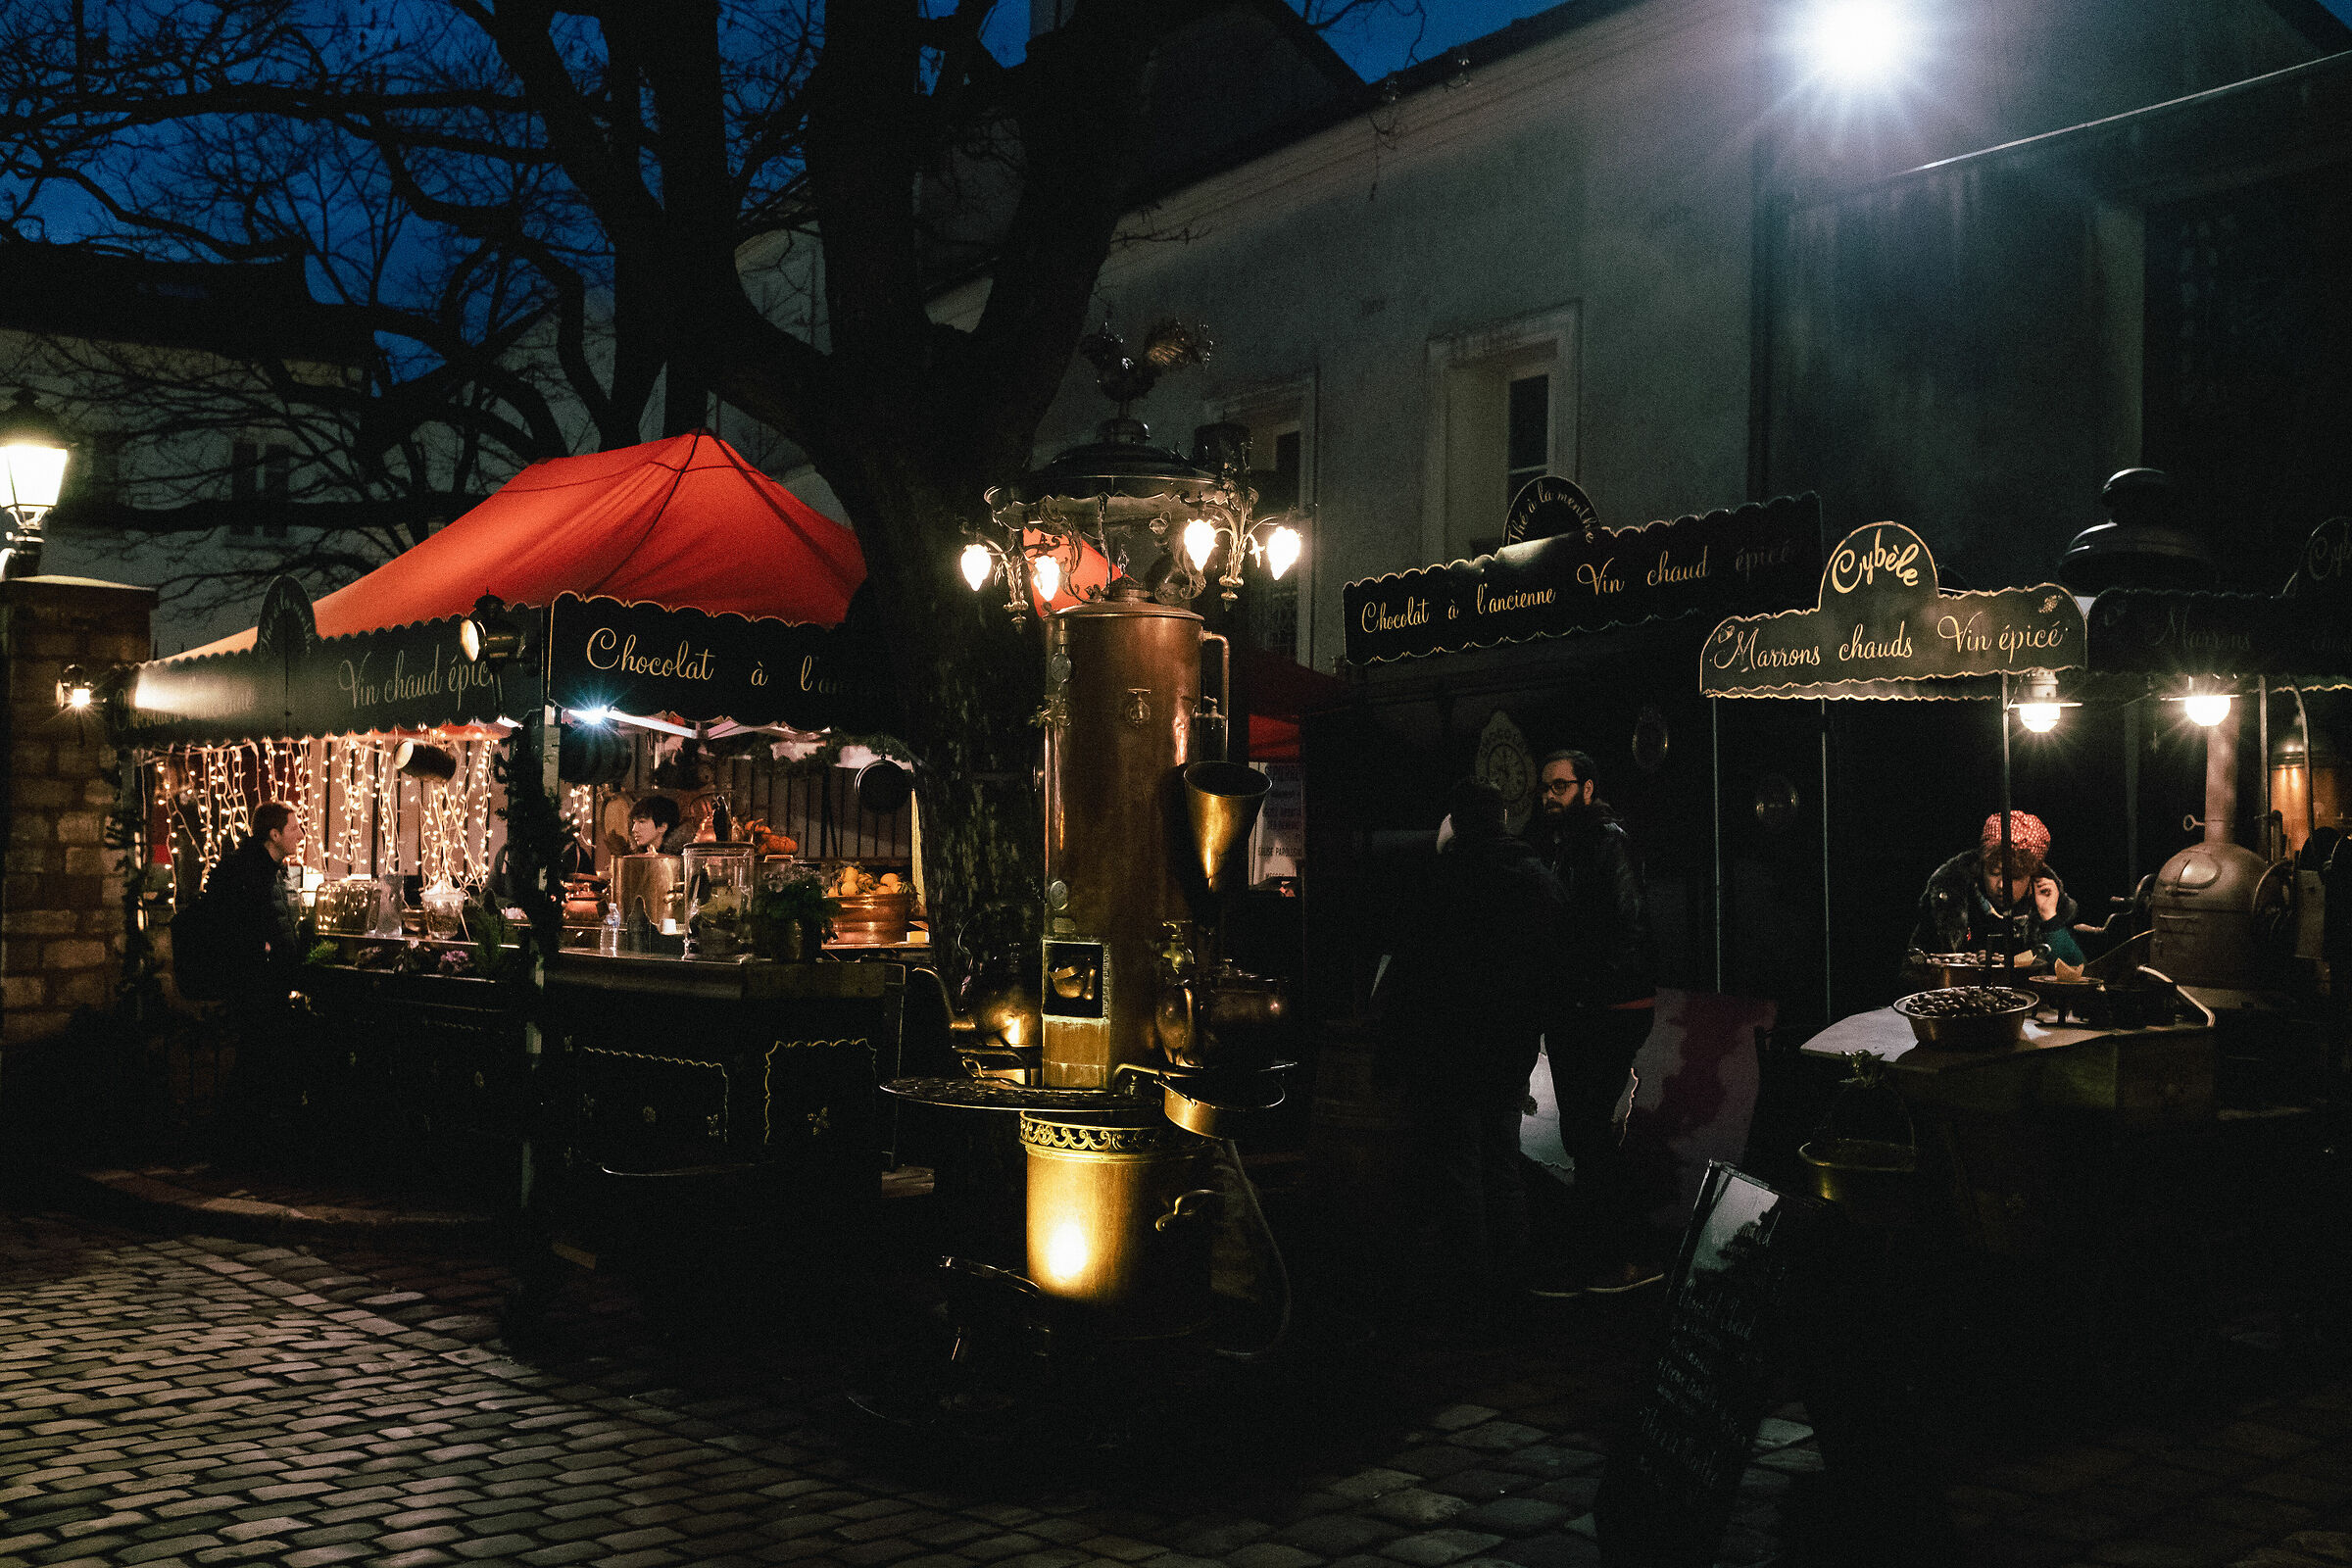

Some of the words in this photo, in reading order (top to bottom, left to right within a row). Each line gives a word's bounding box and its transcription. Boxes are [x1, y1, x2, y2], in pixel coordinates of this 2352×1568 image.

[1526, 497, 1538, 514] à
[1537, 480, 1553, 504] la
[1361, 597, 1431, 635] Chocolat
[1446, 598, 1460, 620] à
[1476, 582, 1557, 615] l'ancienne
[1575, 556, 1626, 596] Vin
[1645, 545, 1710, 587] chaud
[1831, 528, 1920, 594] Cybèle
[586, 627, 716, 681] Chocolat
[750, 661, 769, 687] à
[1713, 627, 1822, 671] Marrons
[1838, 619, 1914, 662] chauds
[1936, 611, 1992, 654] Vin
[1997, 621, 2063, 664] épicé
[338, 651, 381, 710] Vin
[383, 643, 444, 705] chaud
[447, 654, 492, 712] épic
